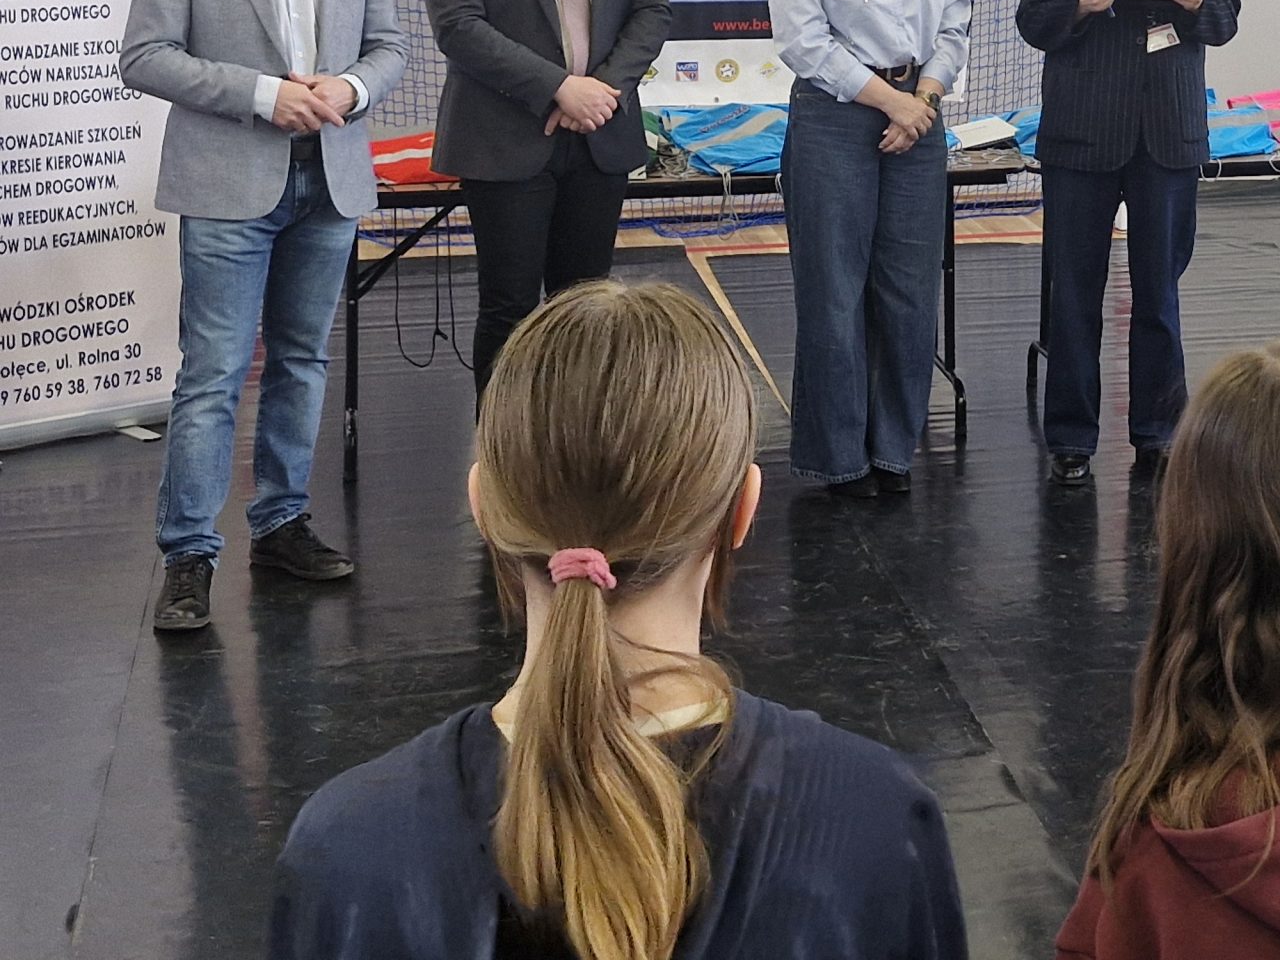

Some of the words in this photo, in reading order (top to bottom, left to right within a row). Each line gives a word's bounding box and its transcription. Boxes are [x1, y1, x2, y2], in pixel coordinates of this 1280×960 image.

[21, 4, 111, 24] DROGOWEGO
[1, 42, 79, 61] OWADZANIE
[5, 92, 49, 110] RUCHU
[53, 87, 142, 107] DROGOWEGO
[87, 120, 141, 144] SZKOLEŃ
[0, 158, 42, 176] KRESIE
[46, 150, 126, 172] KIEROWANIA
[36, 174, 119, 196] DROGOWYM,
[18, 200, 138, 226] REEDUKACYJNYCH,
[24, 235, 48, 252] DLA
[52, 219, 166, 249] EGZAMINATORÓW
[64, 290, 135, 314] OŚRODEK
[21, 318, 129, 348] DROGOWEGO
[56, 353, 73, 370] ul.
[79, 348, 120, 366] Rolna
[124, 343, 142, 359] 30
[14, 385, 41, 404] 760
[45, 382, 63, 399] 59
[68, 379, 89, 395] 38,
[93, 373, 120, 391] 760
[124, 370, 141, 386] 72
[145, 366, 163, 382] 58
